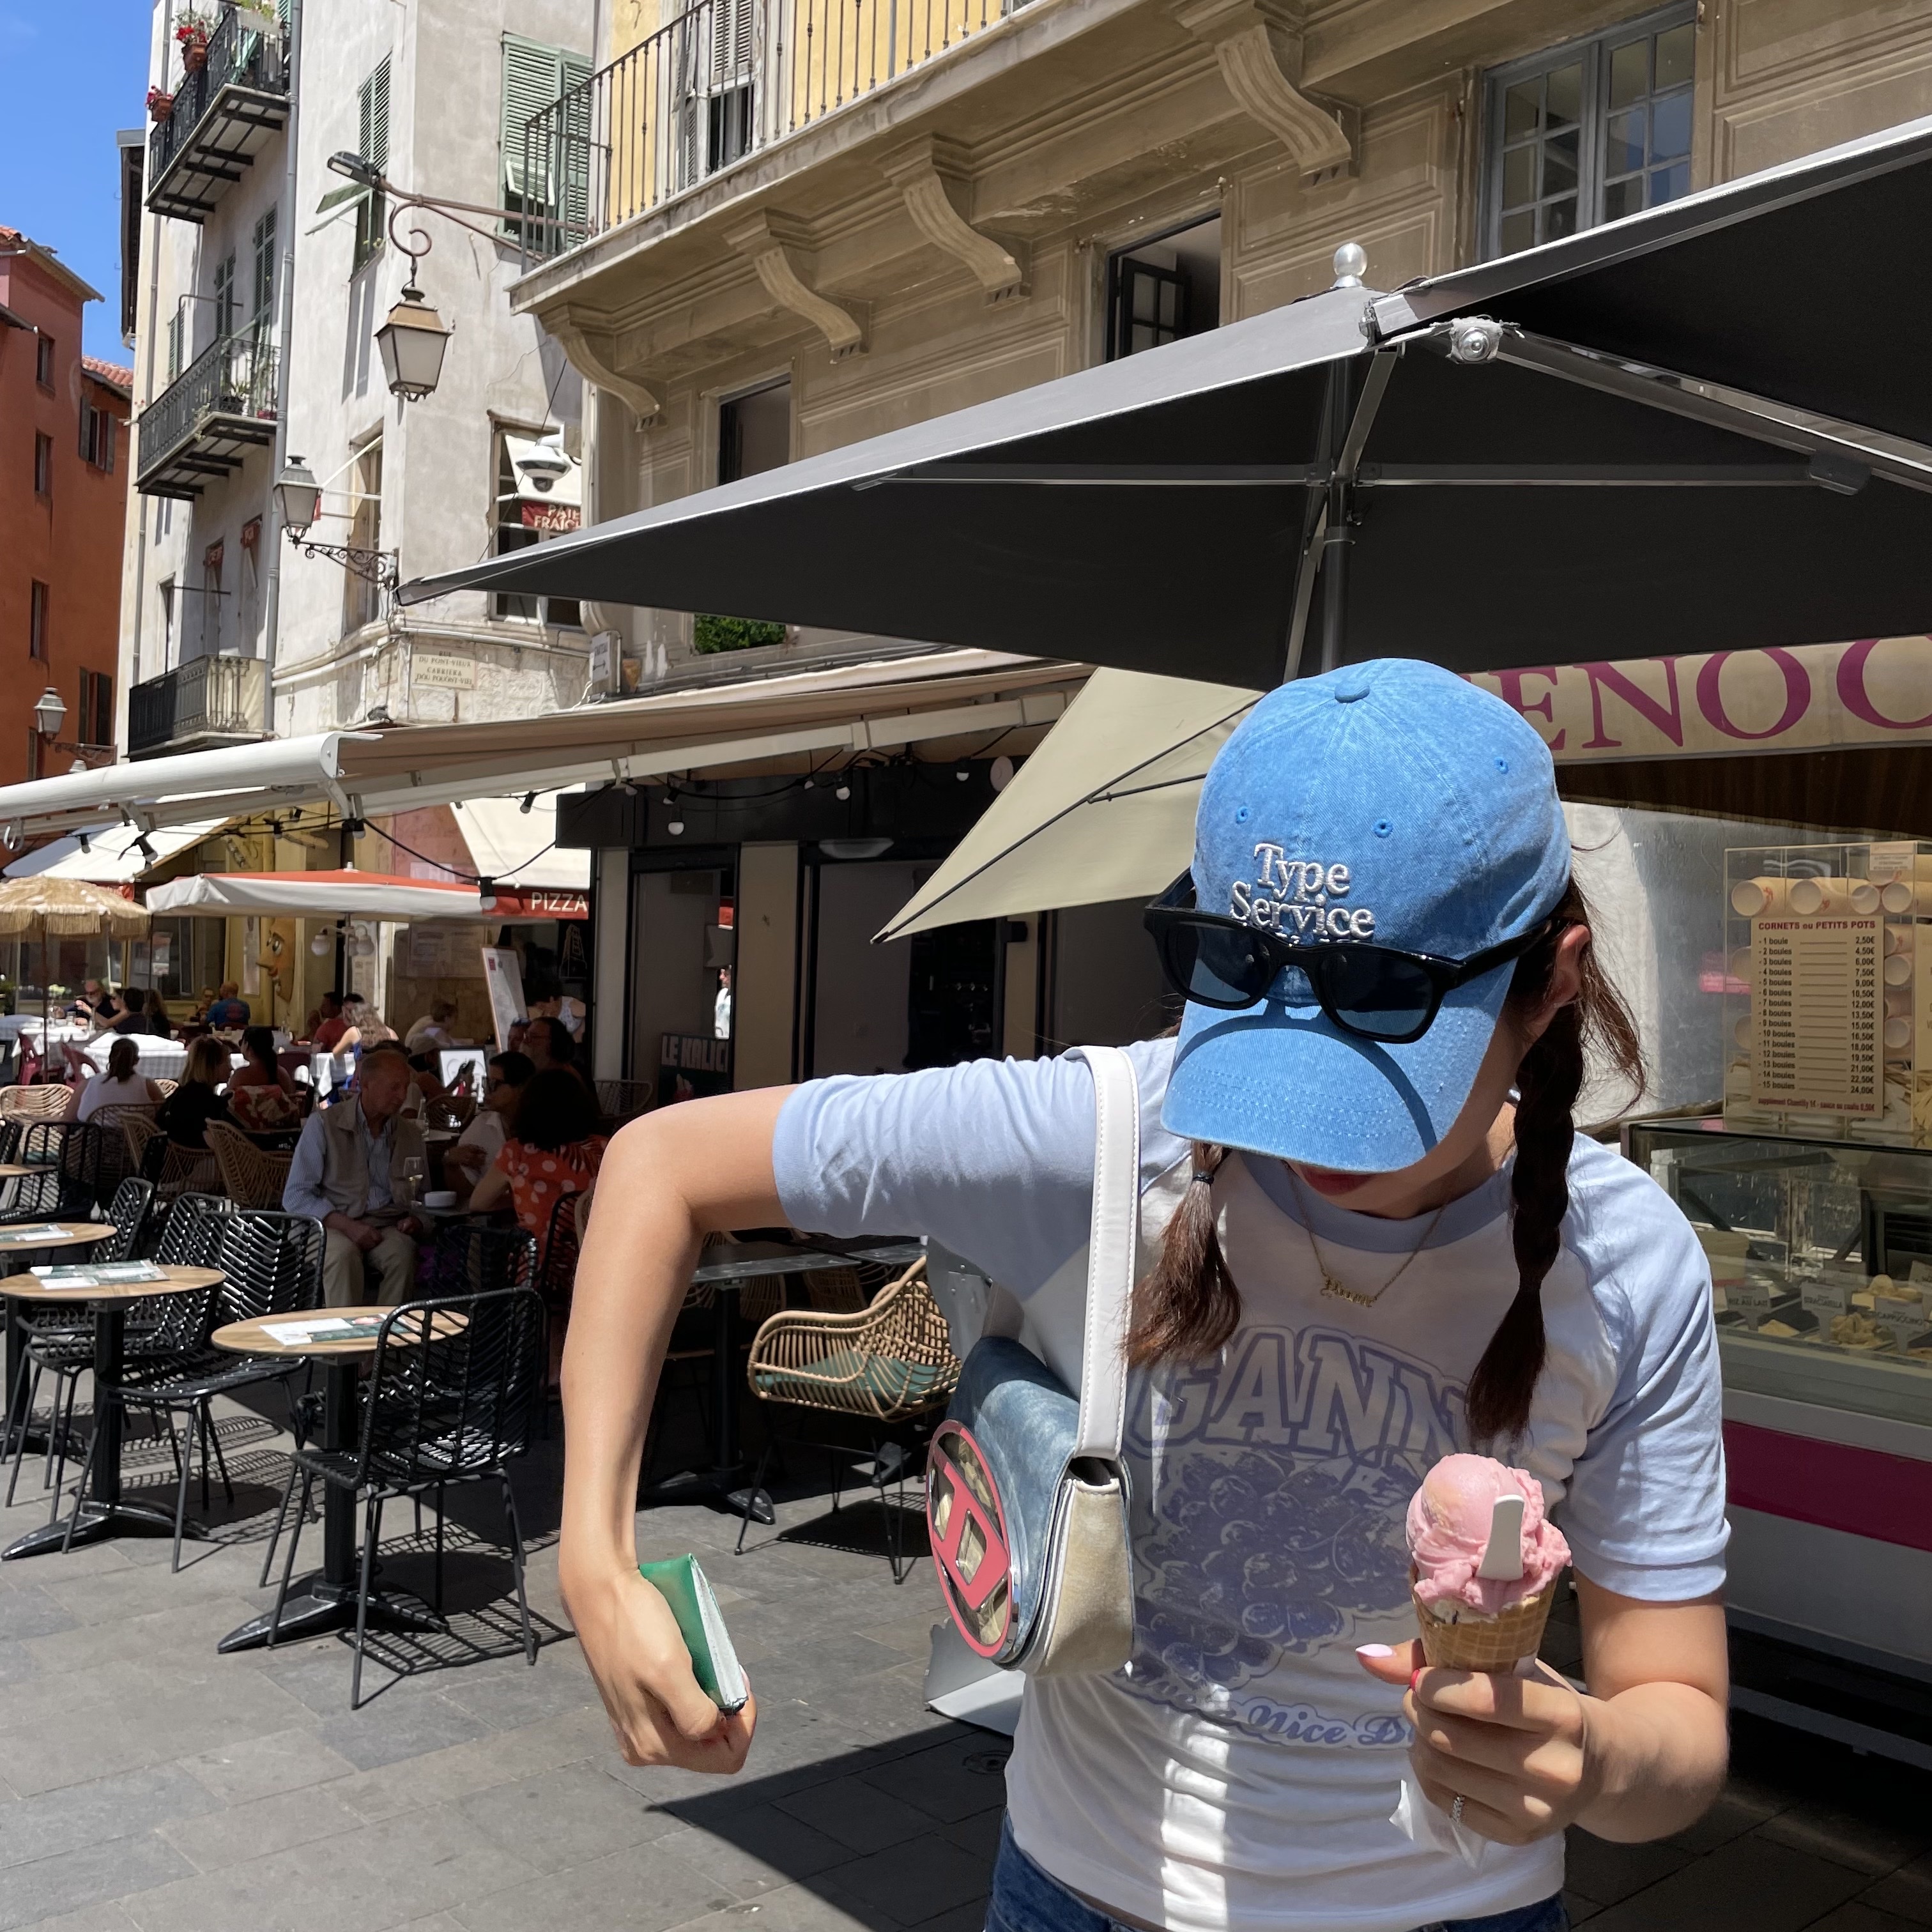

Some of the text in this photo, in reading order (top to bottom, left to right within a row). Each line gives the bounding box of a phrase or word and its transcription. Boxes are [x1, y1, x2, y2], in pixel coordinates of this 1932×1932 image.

[431, 657, 471, 667] PONT-VIEUX
[1254, 843, 1351, 903] Type
[531, 892, 588, 912] PIZZA
[1230, 880, 1375, 939] Service
[1759, 922, 1800, 930] CORNETS
[1816, 921, 1848, 930] PETITS
[1851, 921, 1876, 929] POTS
[1855, 936, 1874, 944] 2,50€
[1855, 947, 1874, 955] 4,50€
[1855, 957, 1874, 966] 6,00€
[1855, 968, 1874, 976] 7,50€
[1855, 979, 1874, 987] 9,00€
[1851, 990, 1874, 998] 10,50€
[1851, 1000, 1874, 1009] 12,00€
[1851, 1011, 1874, 1019] 13,50€
[1769, 1019, 1791, 1027] boules
[1851, 1022, 1874, 1030] 15,00€
[1772, 1029, 1795, 1038] boules
[1851, 1032, 1874, 1041] 16,50€
[661, 1035, 678, 1067] LE
[1851, 1043, 1874, 1052] 18,00€
[1851, 1054, 1874, 1062] 19,50€
[1772, 1061, 1795, 1069] boules
[1850, 1064, 1874, 1073] 21,00€
[1772, 1071, 1795, 1079] boules
[1850, 1075, 1874, 1084] 22,50€
[1772, 1081, 1795, 1089] boules
[1850, 1085, 1874, 1094] 24,00€
